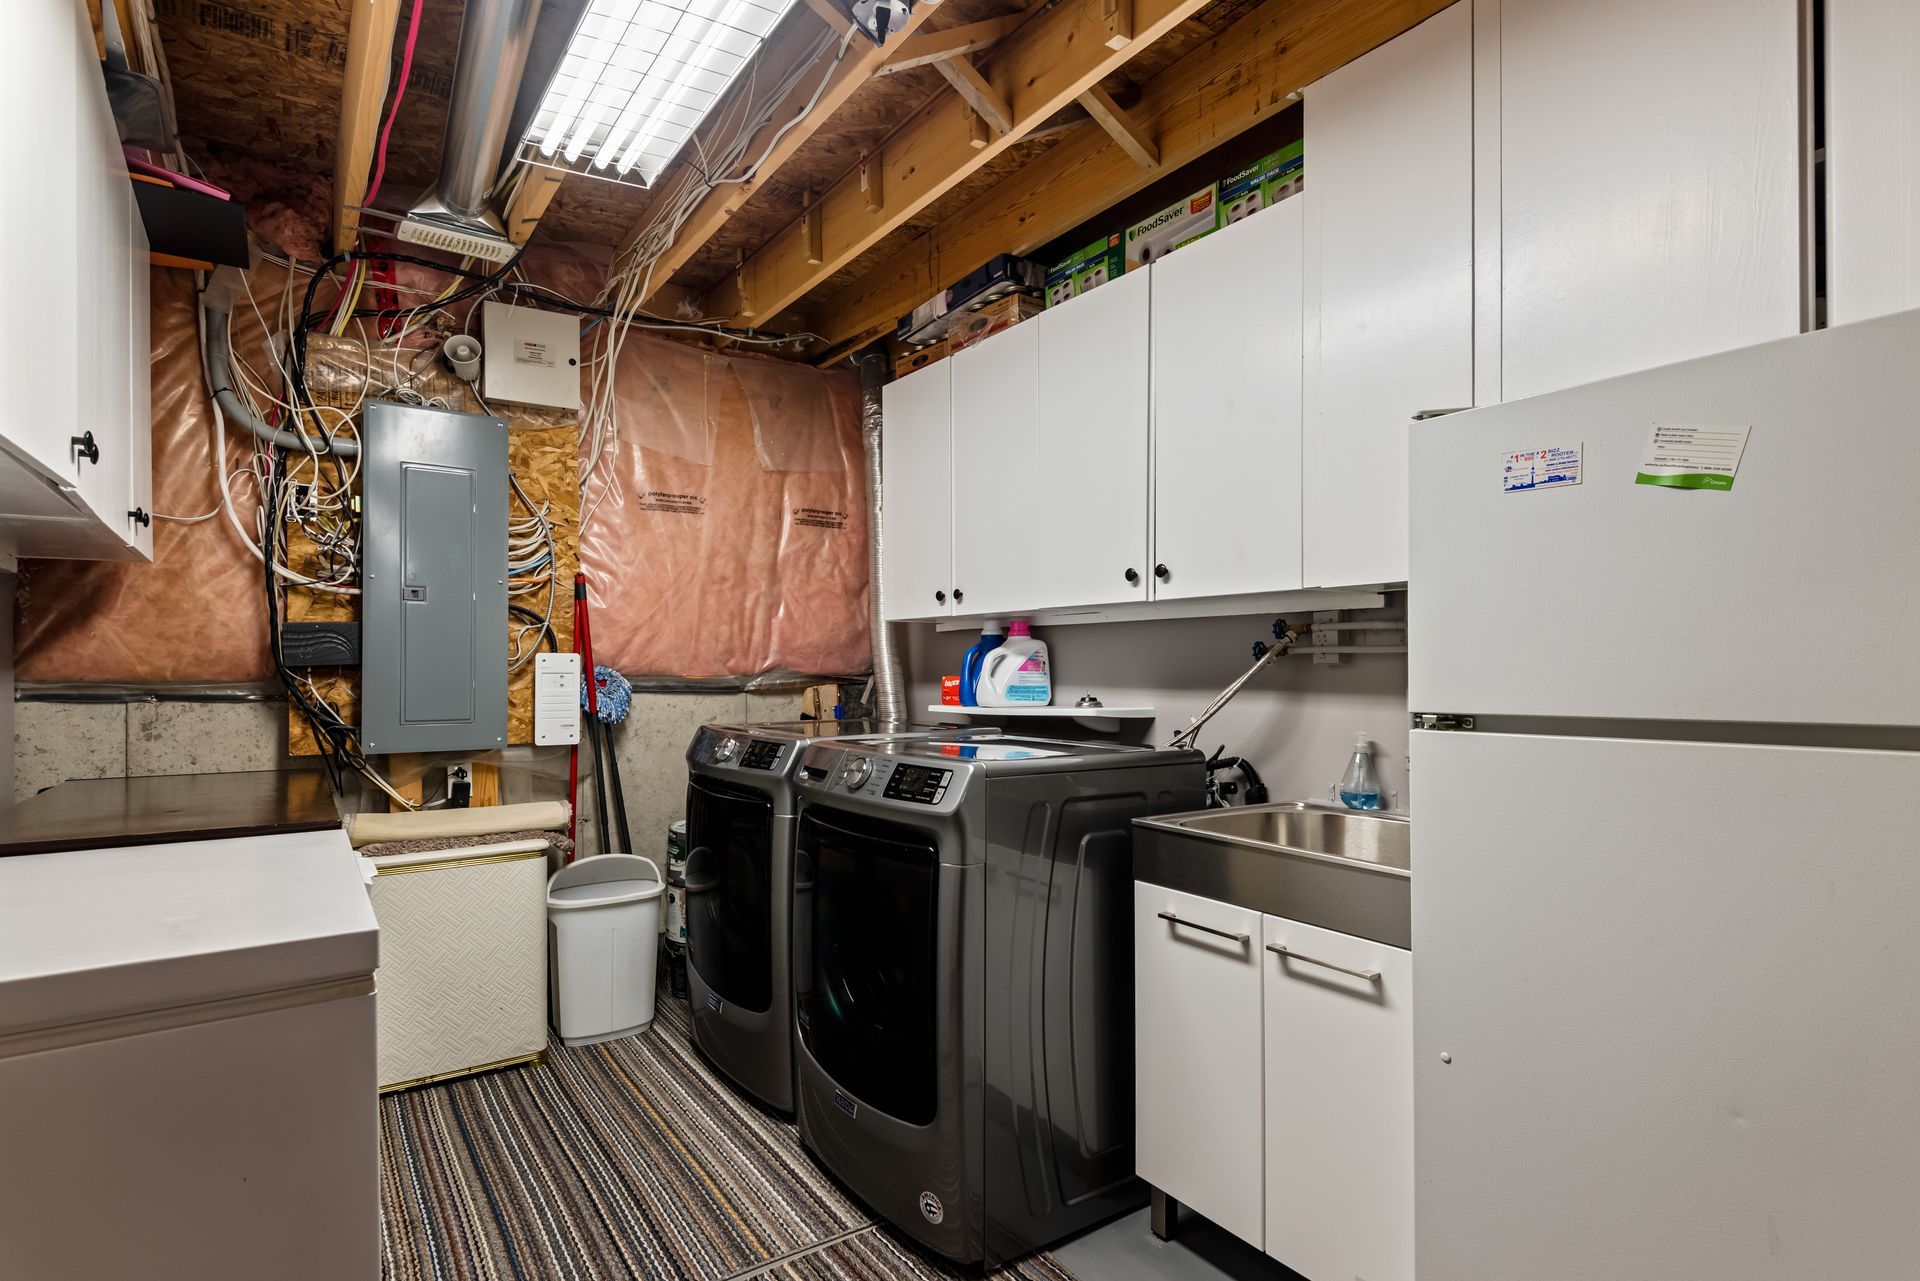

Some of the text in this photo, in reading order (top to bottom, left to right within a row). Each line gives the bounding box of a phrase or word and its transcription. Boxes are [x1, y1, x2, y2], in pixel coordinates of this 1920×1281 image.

[1226, 164, 1260, 185] FoodSaver
[1250, 168, 1280, 186] VALUE PACK
[1137, 205, 1184, 237] FoodSaver
[1050, 259, 1072, 273] FoodSaver
